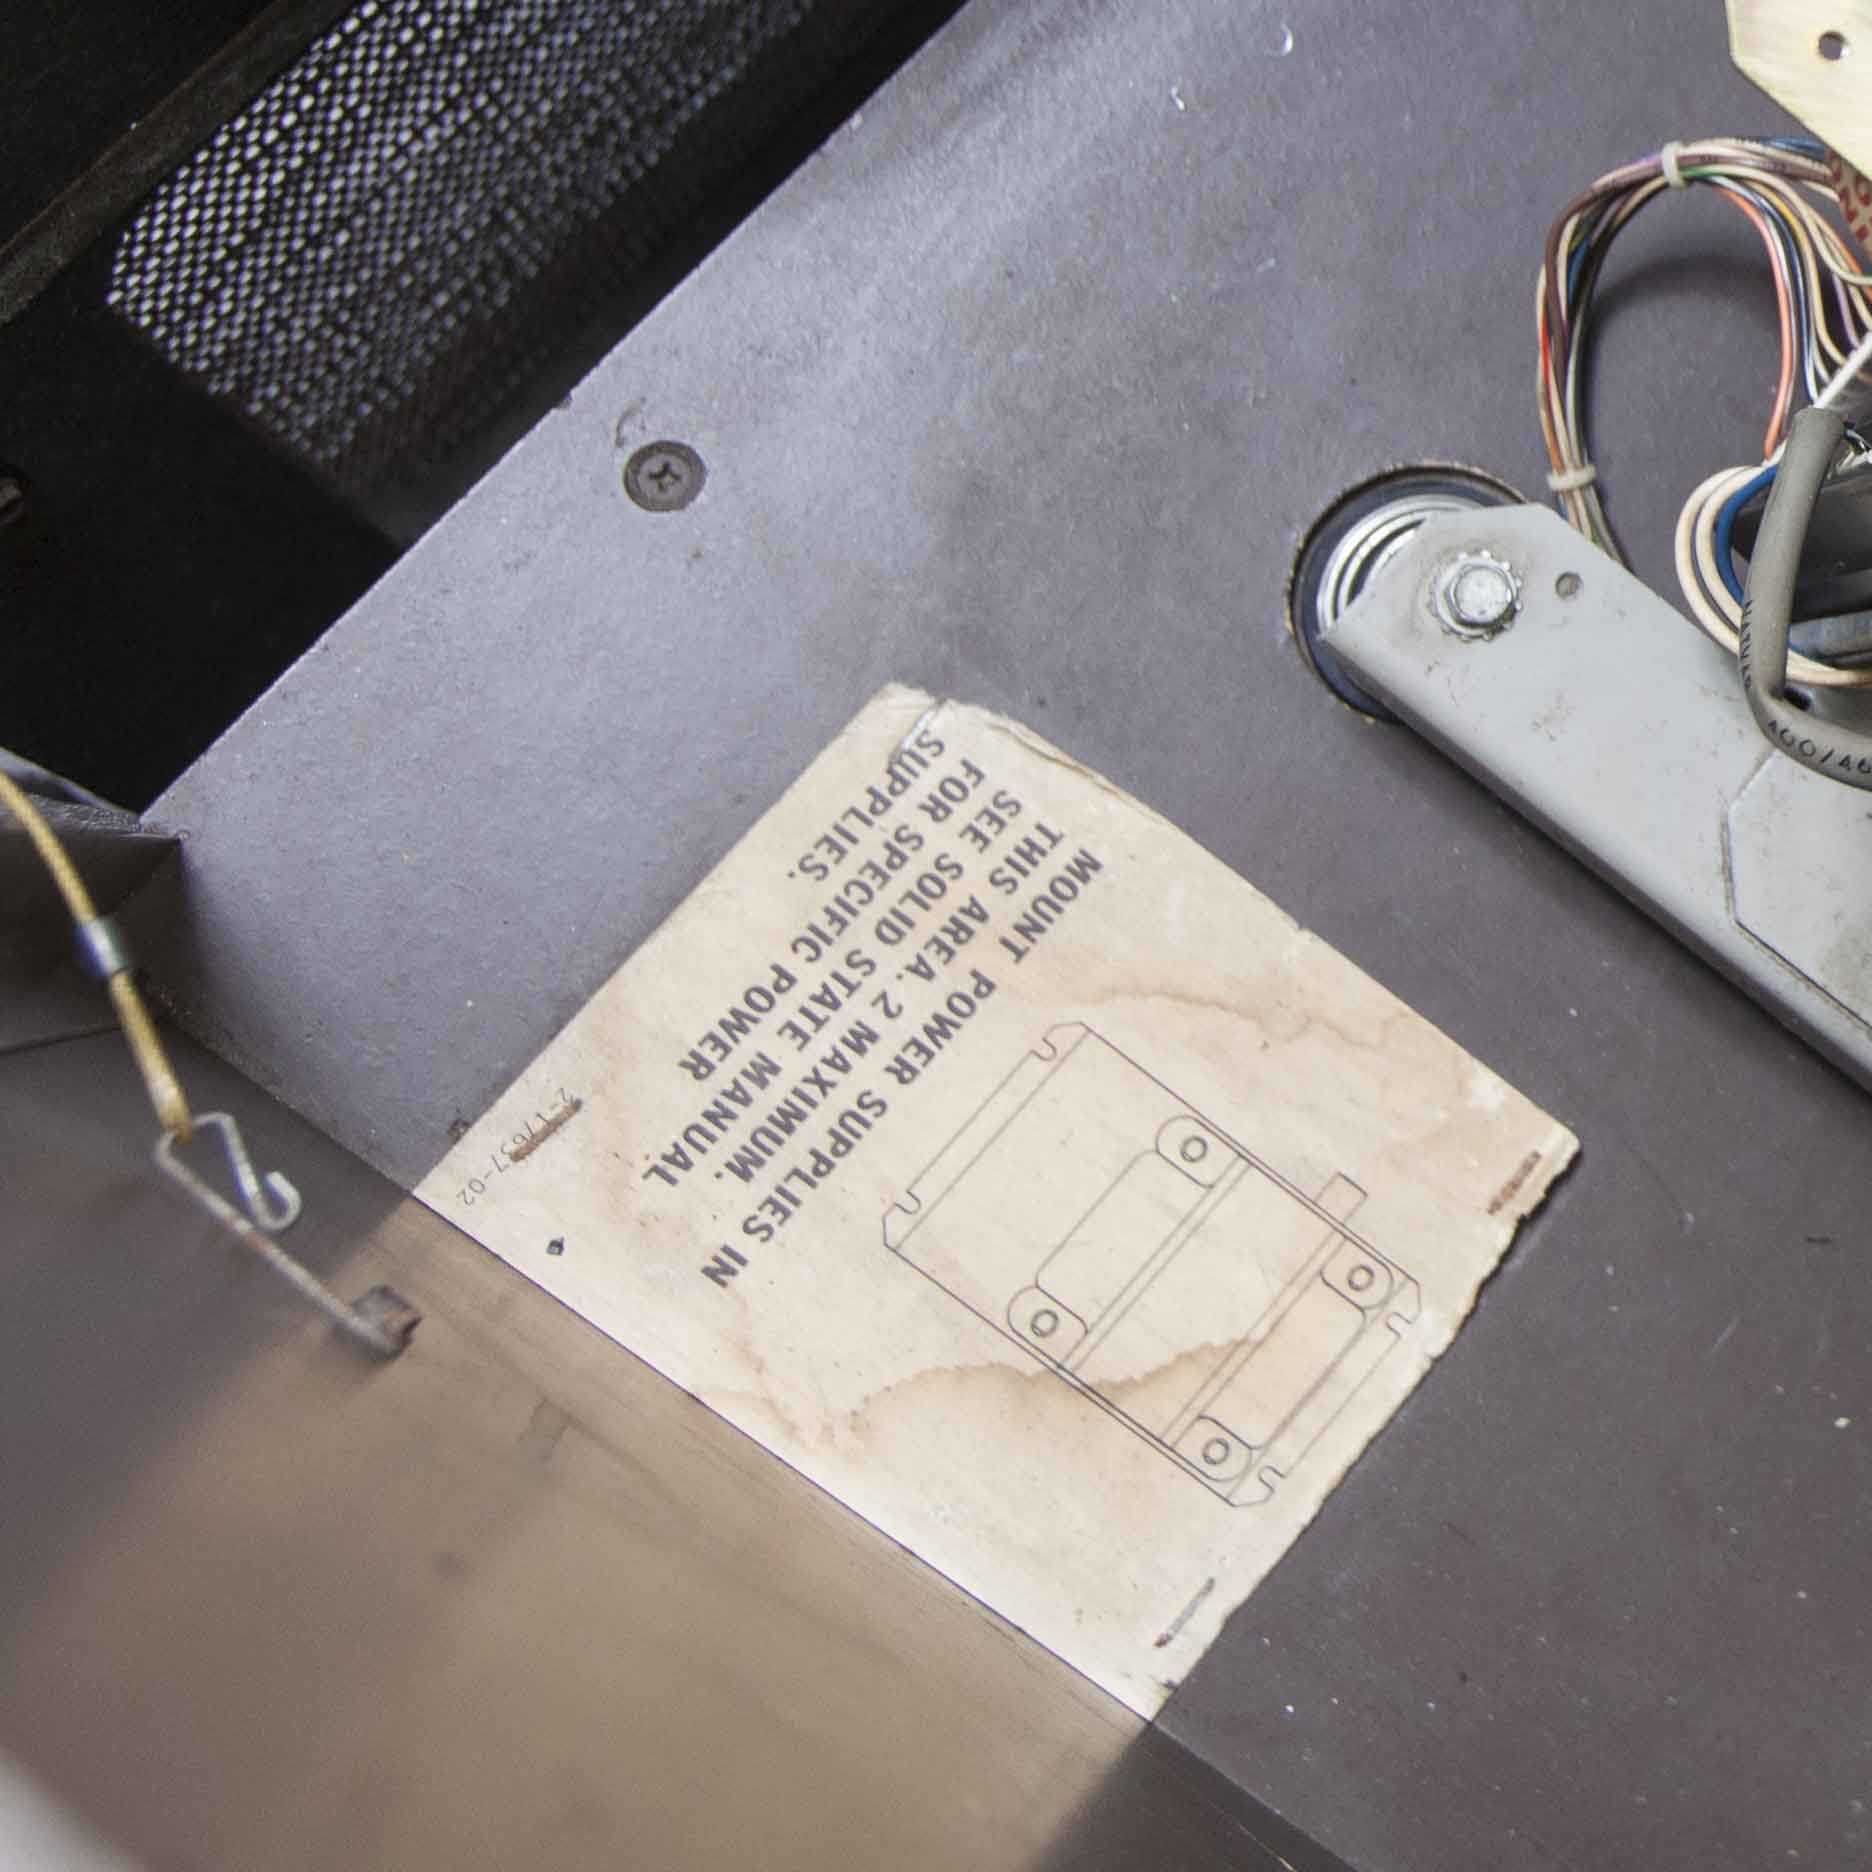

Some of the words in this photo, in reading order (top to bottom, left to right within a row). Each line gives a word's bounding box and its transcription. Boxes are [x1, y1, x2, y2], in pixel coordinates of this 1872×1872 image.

[785, 728, 945, 883] SUPPLIES.
[915, 756, 985, 825] FOR
[957, 788, 1023, 855] SEE
[789, 823, 925, 964] SPECIFIC
[872, 859, 966, 949] SOLID
[987, 819, 1064, 896] THIS
[998, 847, 1104, 966] MOUNT
[895, 894, 992, 982] AREA.
[677, 962, 798, 1082] POWER
[775, 948, 877, 1052] STATE
[868, 987, 905, 1021] 2
[883, 968, 997, 1087] POWER
[640, 1049, 782, 1188] MANUAL
[713, 1019, 882, 1186] MAXIMUM.
[740, 1087, 889, 1244] SUPPLIES
[699, 1243, 750, 1289] IN
